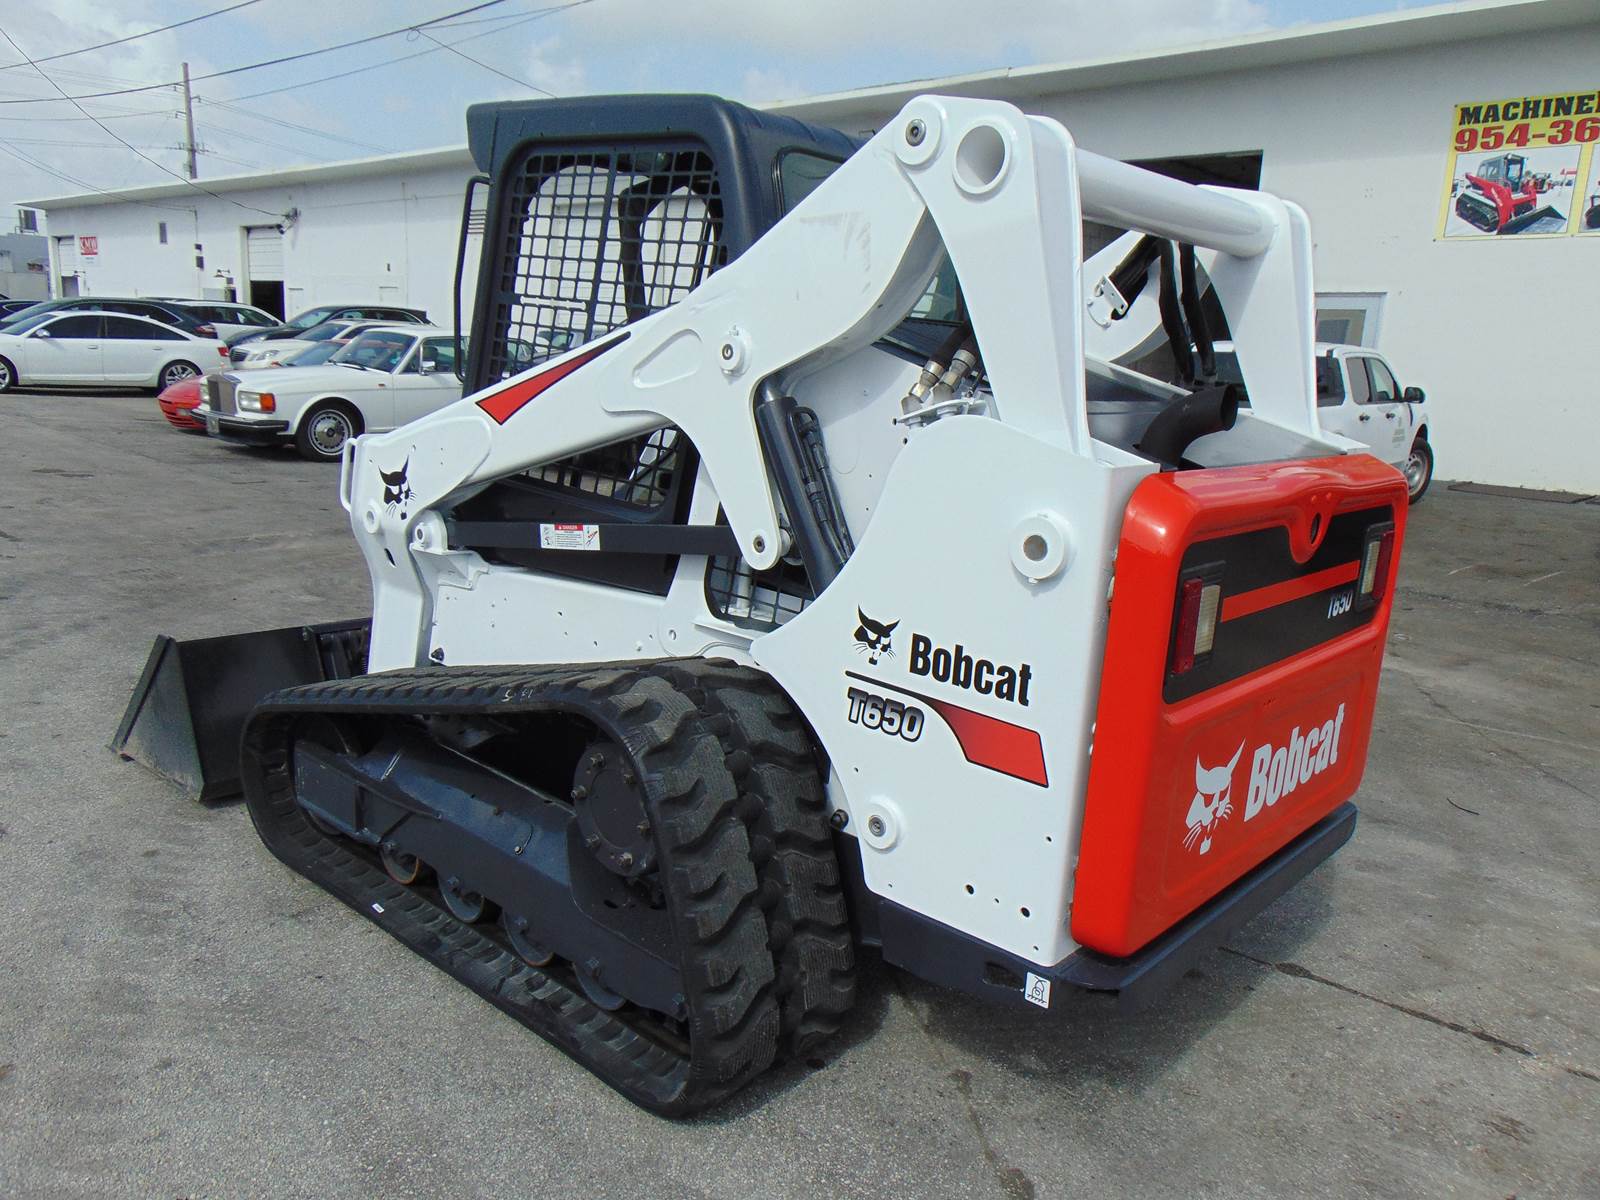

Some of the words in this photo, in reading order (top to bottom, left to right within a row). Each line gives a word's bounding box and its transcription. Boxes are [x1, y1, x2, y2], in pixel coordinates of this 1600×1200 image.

[1454, 117, 1600, 152] 954-36
[1459, 93, 1600, 126] MACHINE
[909, 633, 1032, 707] Bobcat
[847, 686, 925, 743] T650
[1243, 702, 1345, 822] Bobcat
